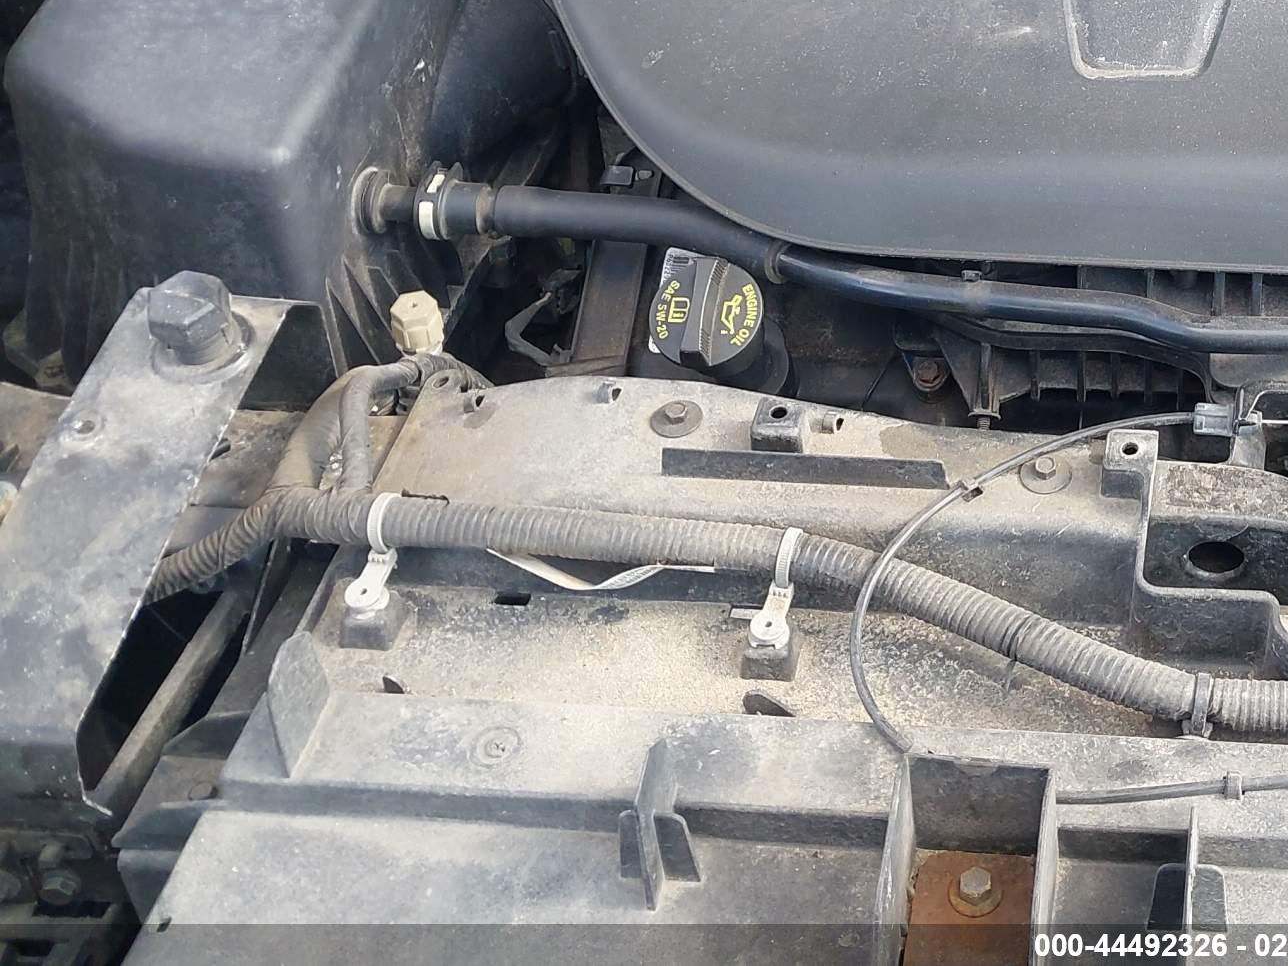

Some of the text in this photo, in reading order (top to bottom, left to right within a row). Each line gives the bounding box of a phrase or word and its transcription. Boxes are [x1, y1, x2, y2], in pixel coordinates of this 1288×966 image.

[660, 280, 681, 302] SAE
[655, 303, 669, 339] 5W-20
[730, 284, 758, 346] ENGINE OIL
